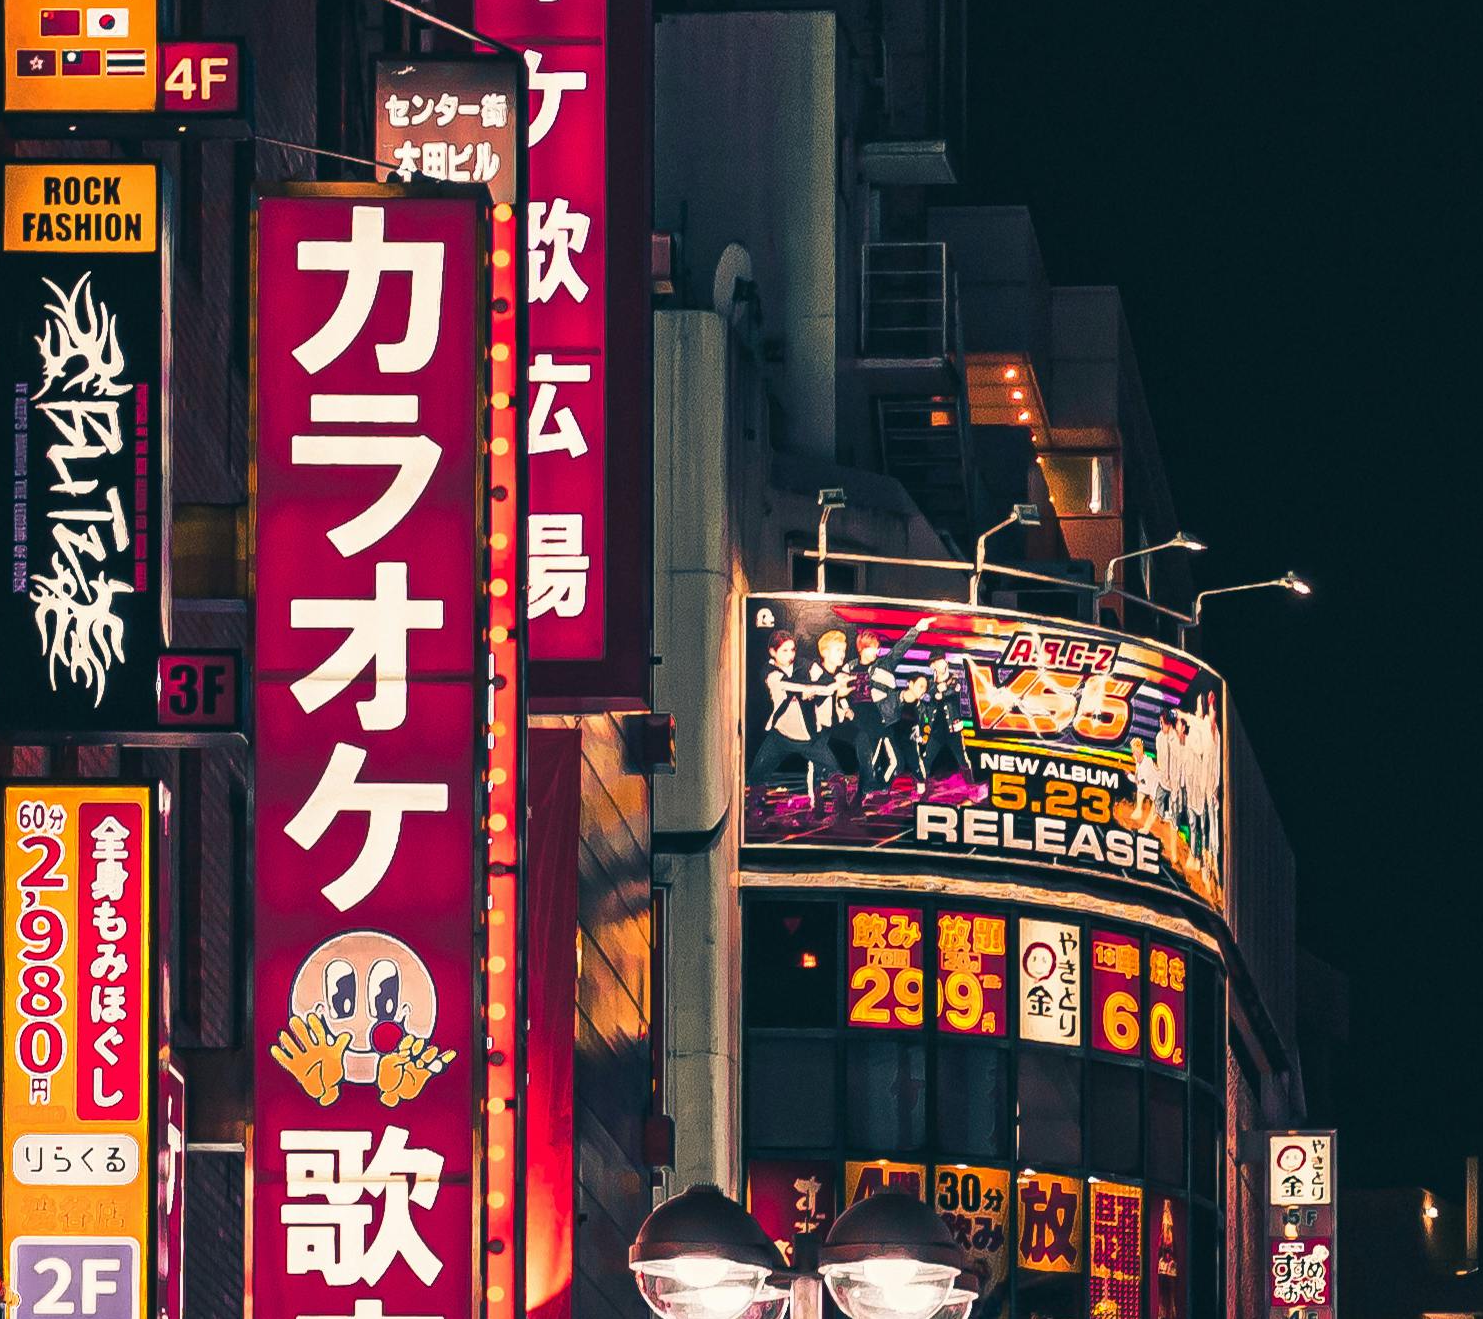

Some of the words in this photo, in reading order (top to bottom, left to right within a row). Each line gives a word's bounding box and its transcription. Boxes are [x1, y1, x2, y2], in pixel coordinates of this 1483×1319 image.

[163, 57, 230, 102] 4F
[384, 92, 508, 129] センター街
[42, 174, 122, 207] ROCK
[21, 211, 144, 245] FASHION
[283, 205, 449, 914] カラオケ
[168, 665, 225, 716] 3F
[978, 751, 1038, 776] NEW
[1042, 761, 1121, 790] ALBUM
[16, 801, 67, 833] 60分
[989, 773, 1114, 826] 5.23
[916, 804, 1164, 876] RELEASE
[15, 834, 68, 1107] 2,980円
[88, 815, 130, 1107] 全身もみほぐし
[1057, 930, 1077, 1039] やきとり
[1025, 984, 1054, 1018] 金
[24, 1143, 128, 1176] りらくる
[937, 1171, 1005, 1213] 30分
[1019, 1180, 1079, 1266] 放
[32, 1258, 122, 1316] 2F
